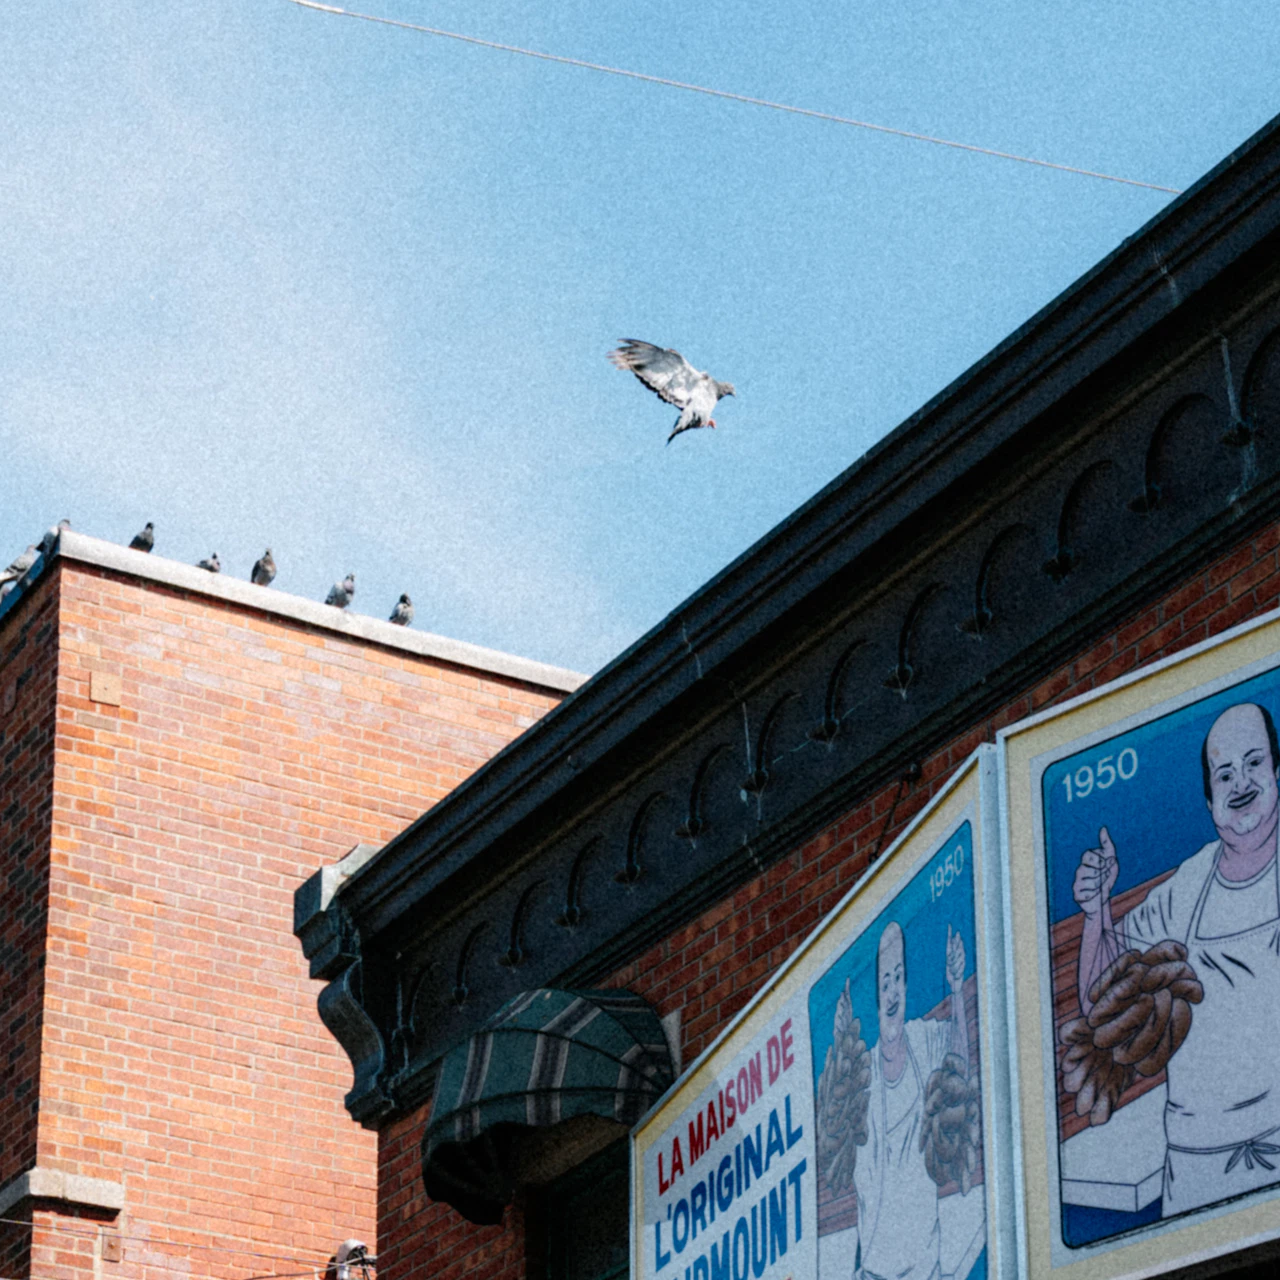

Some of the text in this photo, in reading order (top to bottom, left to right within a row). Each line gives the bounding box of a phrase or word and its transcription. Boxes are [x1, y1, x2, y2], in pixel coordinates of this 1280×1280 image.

[1060, 747, 1139, 804] 1950
[928, 843, 966, 904] 1950
[657, 1018, 795, 1197] LA MAISON DE
[654, 1094, 804, 1272] L'ORIGINAL
